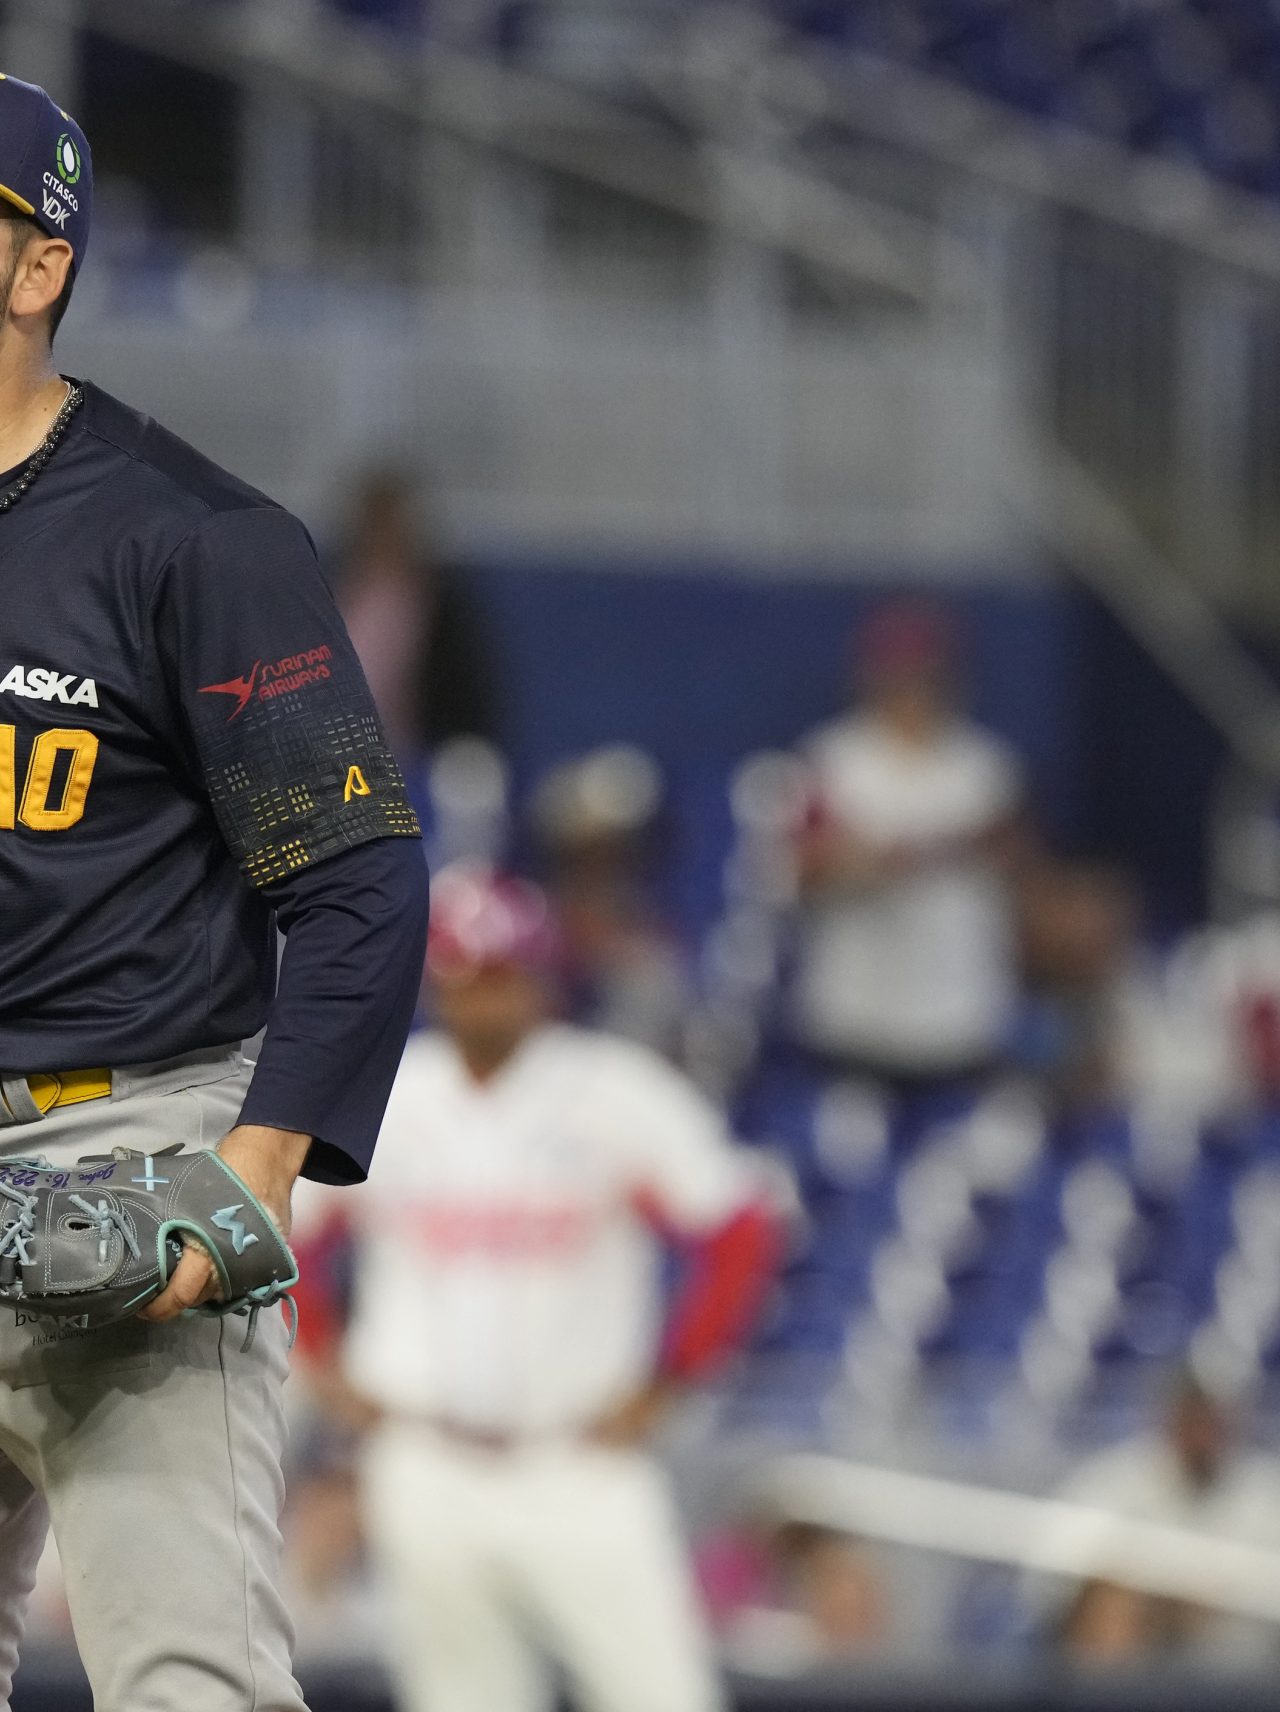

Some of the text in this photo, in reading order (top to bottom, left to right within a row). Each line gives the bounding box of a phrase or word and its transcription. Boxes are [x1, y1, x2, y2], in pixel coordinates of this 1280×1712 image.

[42, 171, 79, 212] CITASCO
[259, 664, 331, 702] AIRWAYS
[261, 645, 333, 684] SURINAM
